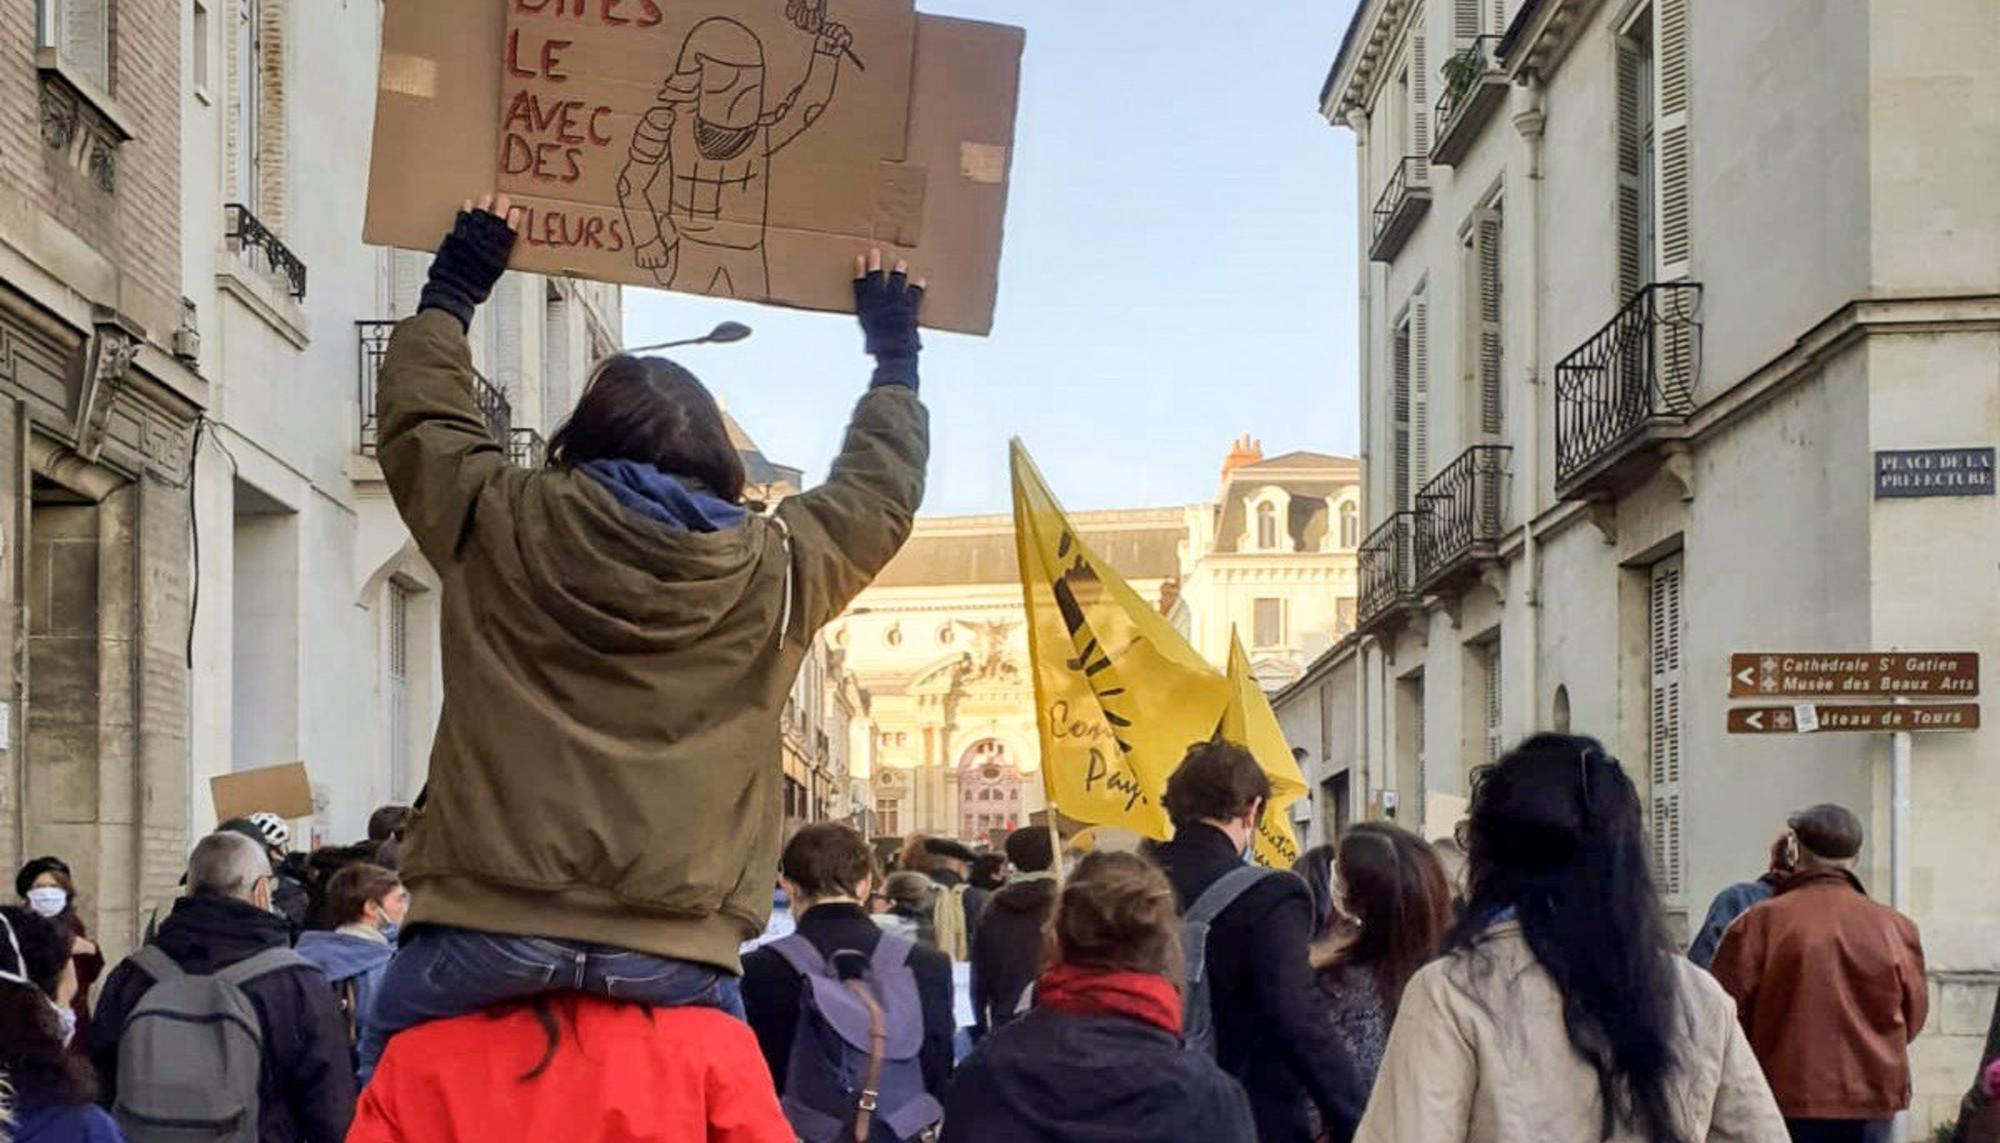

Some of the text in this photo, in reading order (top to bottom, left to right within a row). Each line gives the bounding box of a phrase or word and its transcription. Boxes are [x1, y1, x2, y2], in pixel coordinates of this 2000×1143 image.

[507, 28, 573, 81] LE
[504, 89, 613, 147] AVEC
[503, 133, 583, 183] DES
[1881, 455, 1991, 470] PLACE DE LA
[1783, 657, 1870, 672] Cathédrale
[1905, 657, 1958, 671] Gatien
[1843, 676, 1870, 690] des
[1880, 676, 1929, 691] Beaux
[1941, 676, 1975, 690] Arts
[1881, 710, 1902, 726] de
[1912, 709, 1961, 725] Tours
